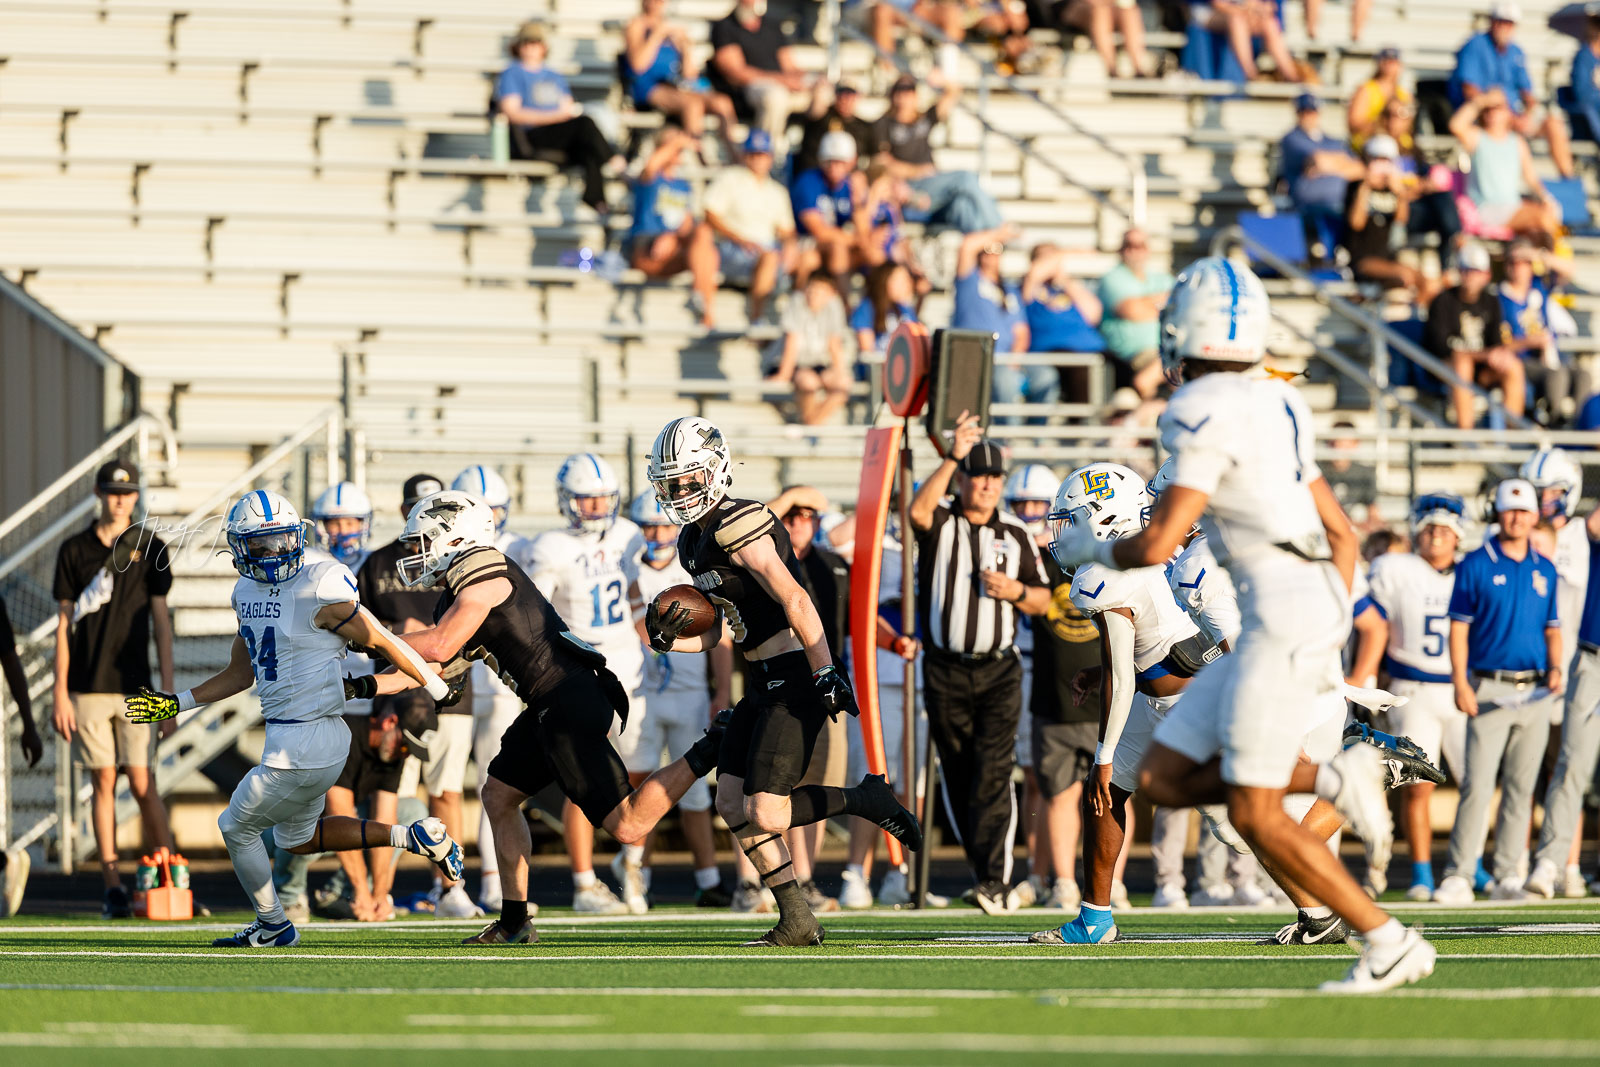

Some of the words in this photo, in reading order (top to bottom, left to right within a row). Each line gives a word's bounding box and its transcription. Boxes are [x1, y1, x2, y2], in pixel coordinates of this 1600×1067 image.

[241, 602, 282, 619] EAGLES
[589, 580, 624, 627] 12
[1423, 615, 1444, 657] 5
[1204, 647, 1223, 662] BATTL
